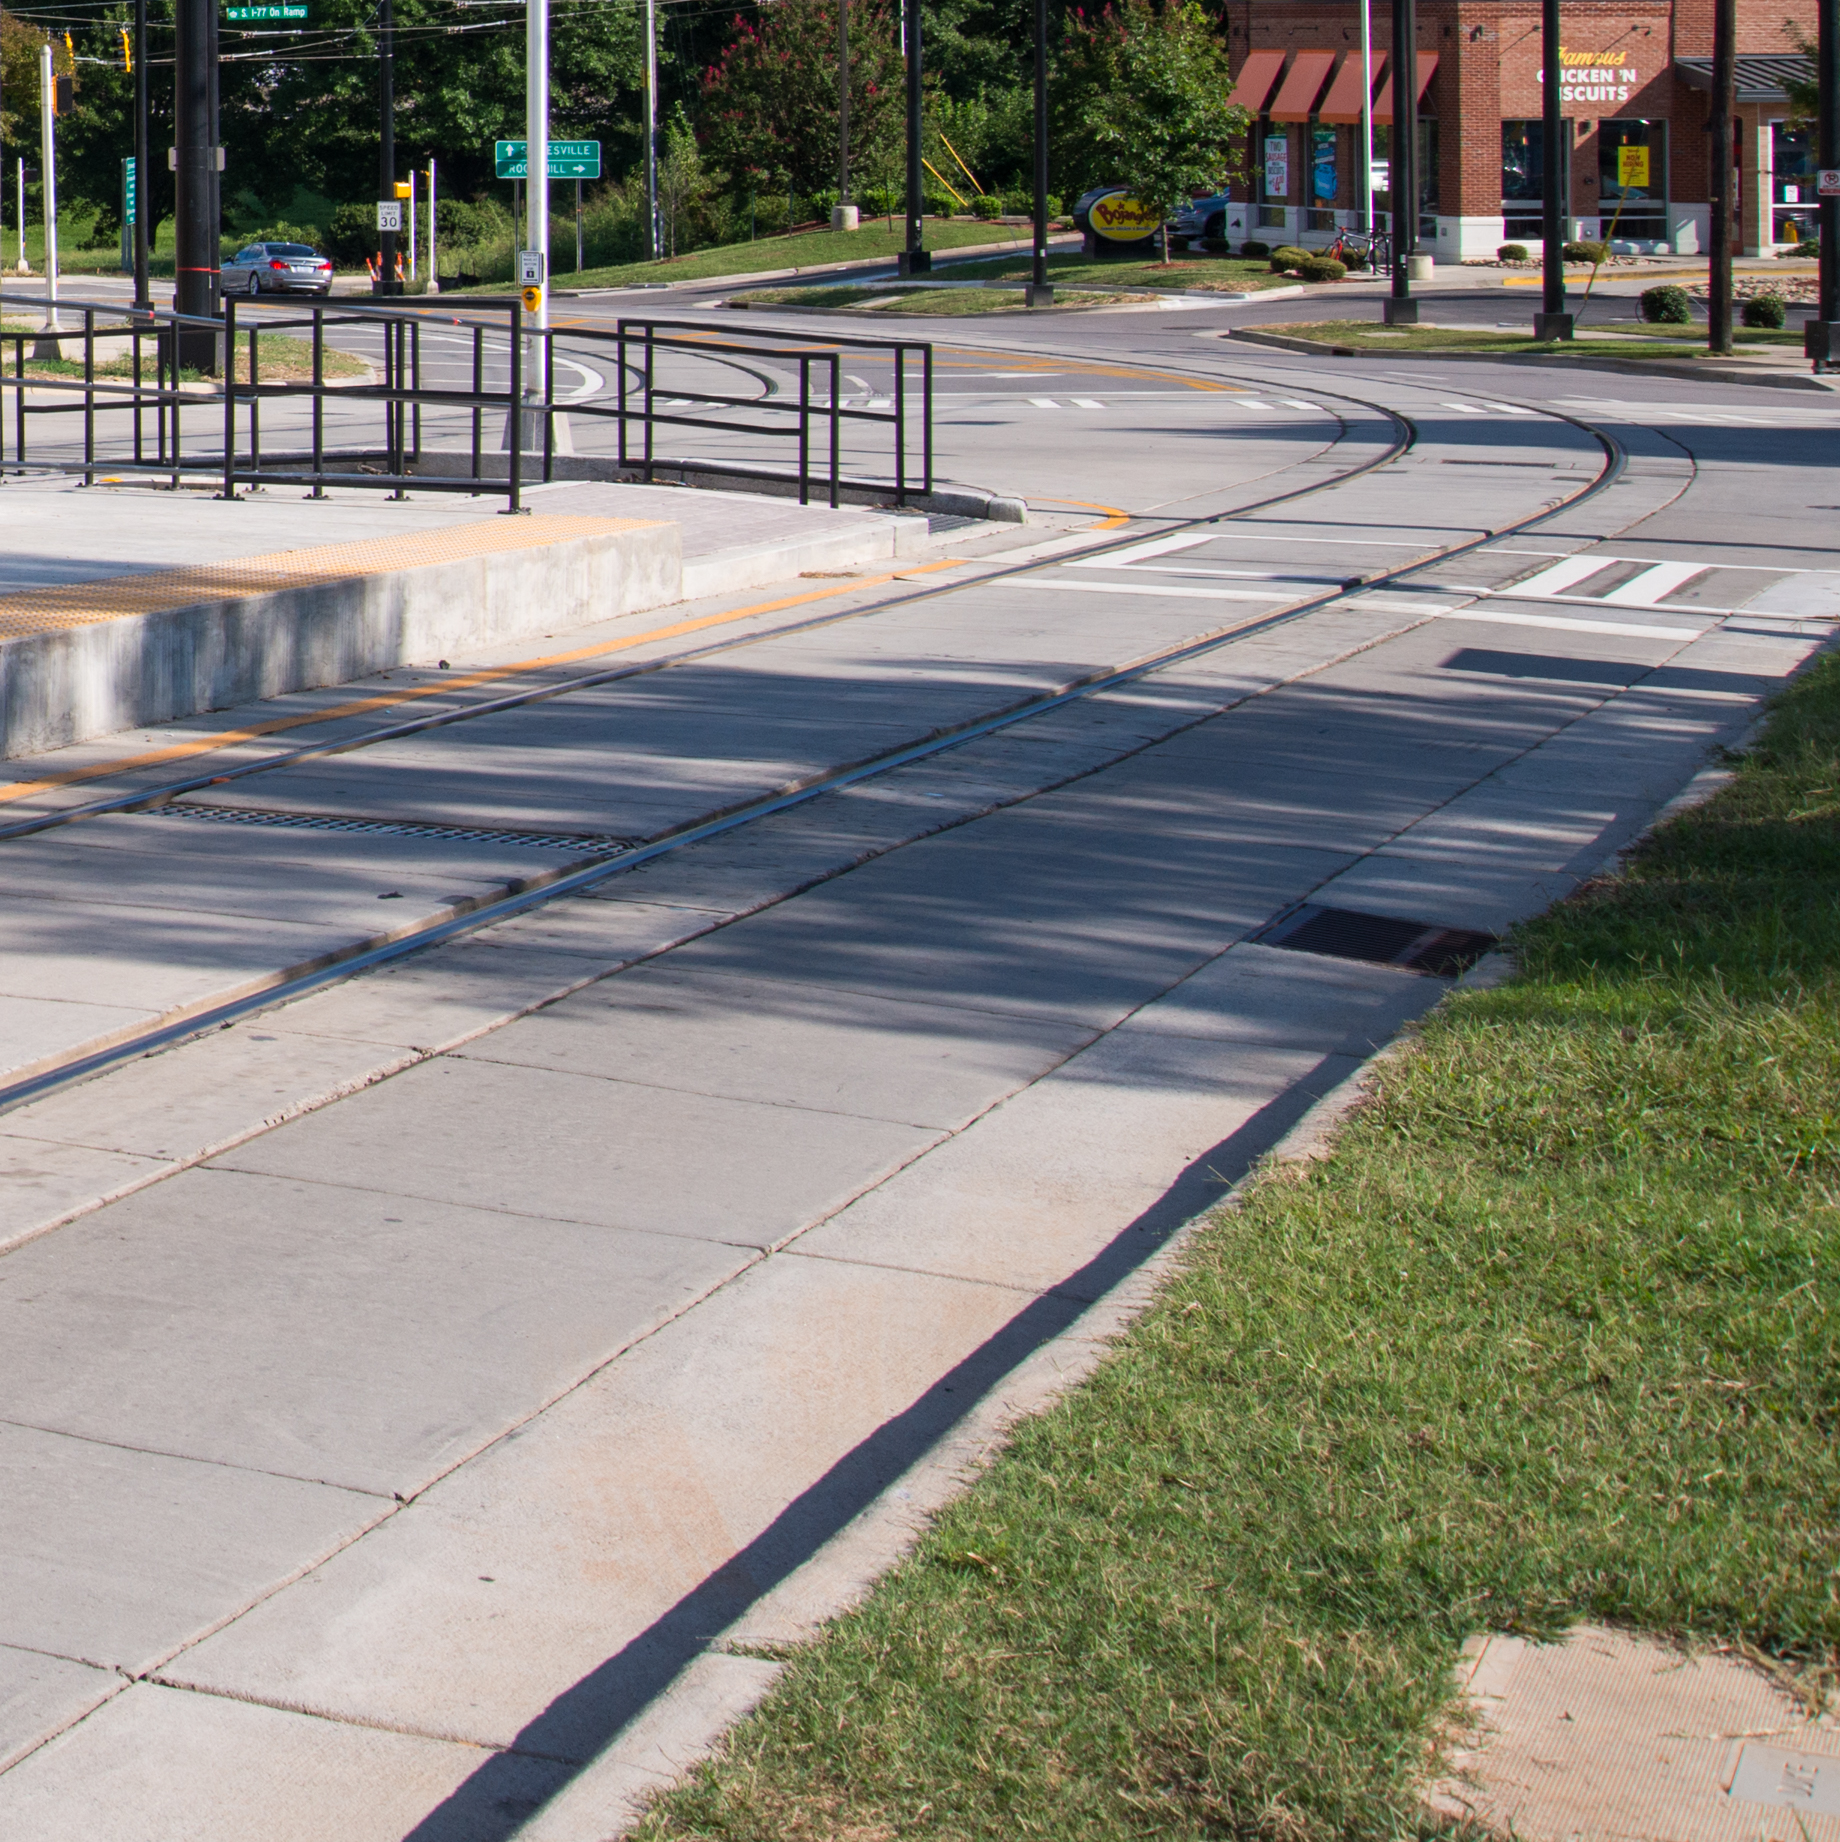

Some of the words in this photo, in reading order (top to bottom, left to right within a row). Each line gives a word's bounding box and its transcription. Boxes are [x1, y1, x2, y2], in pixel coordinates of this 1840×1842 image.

[241, 8, 248, 18] S.
[251, 7, 267, 17] I-77
[269, 8, 280, 17] On
[283, 7, 306, 17] Ramp
[1536, 69, 1614, 83] CICKEN
[1559, 86, 1629, 101] ISCUITS
[520, 145, 590, 156] SESVILLE
[509, 164, 528, 173] ROC
[380, 216, 397, 227] 30
